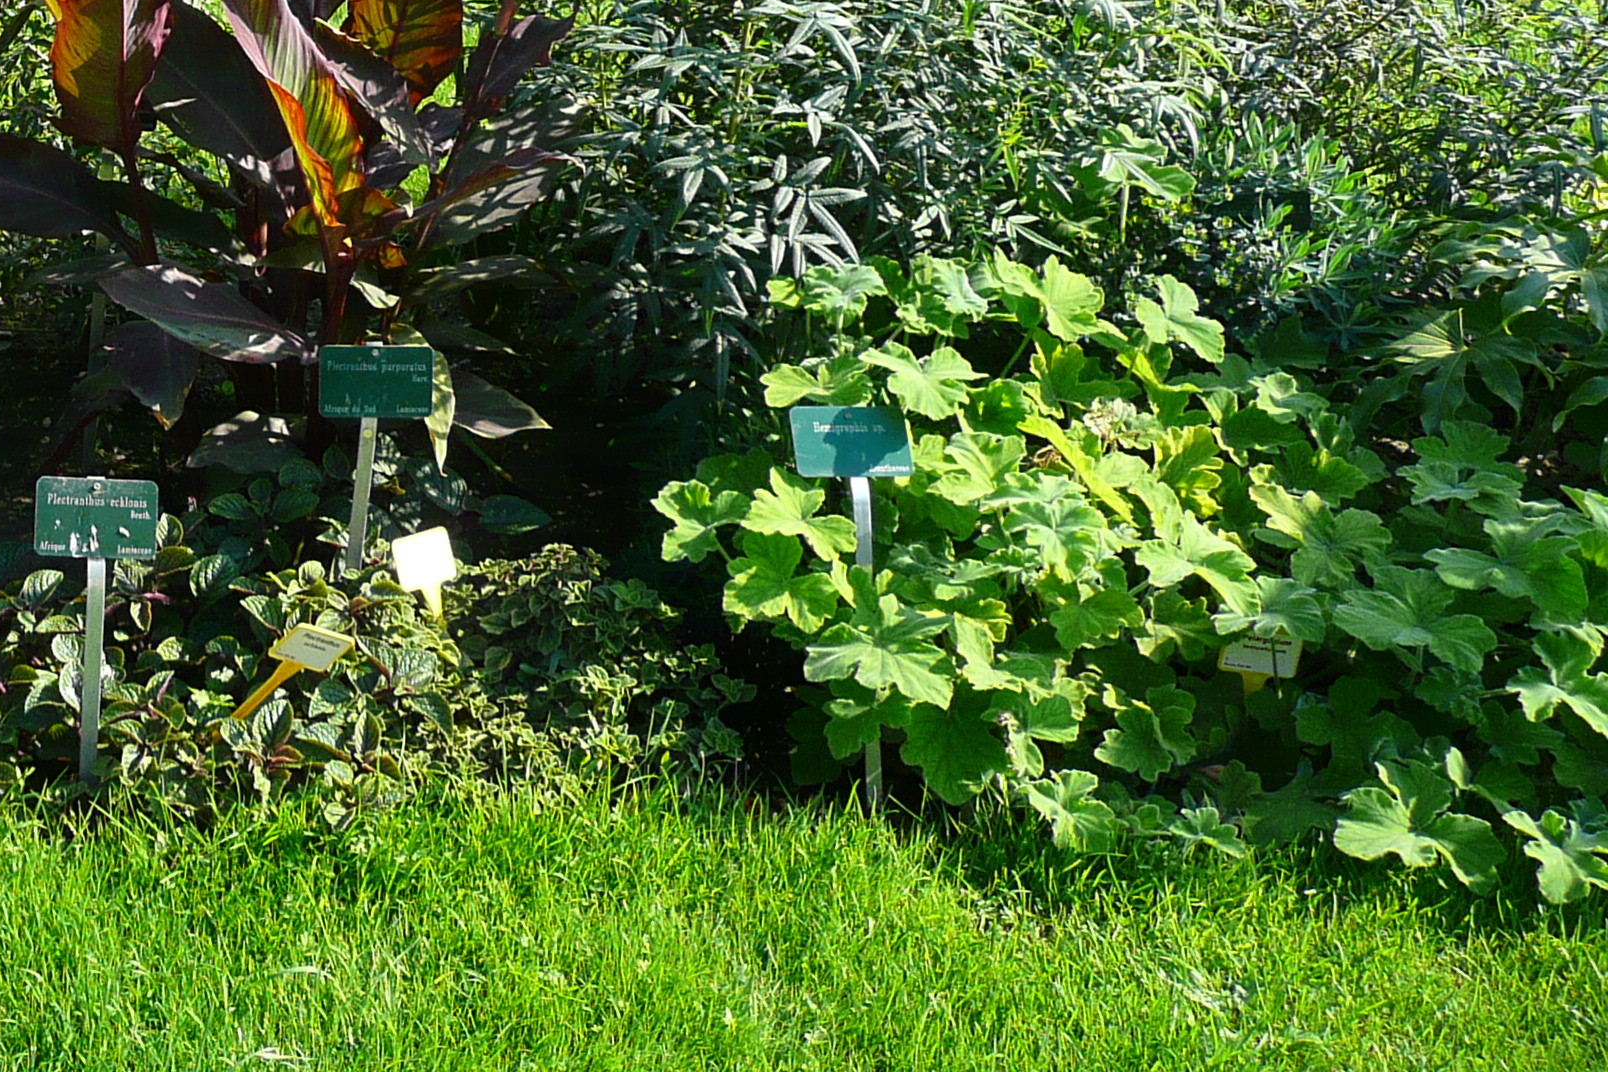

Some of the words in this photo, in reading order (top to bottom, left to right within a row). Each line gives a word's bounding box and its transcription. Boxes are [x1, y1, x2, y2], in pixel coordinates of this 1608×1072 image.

[327, 361, 377, 371] Plectranthus
[381, 361, 427, 373] purpuratus
[47, 493, 105, 507] Plectranthus
[110, 496, 148, 508] ecklonis
[39, 540, 66, 553] Afrique
[117, 544, 152, 555] Lamiaceae
